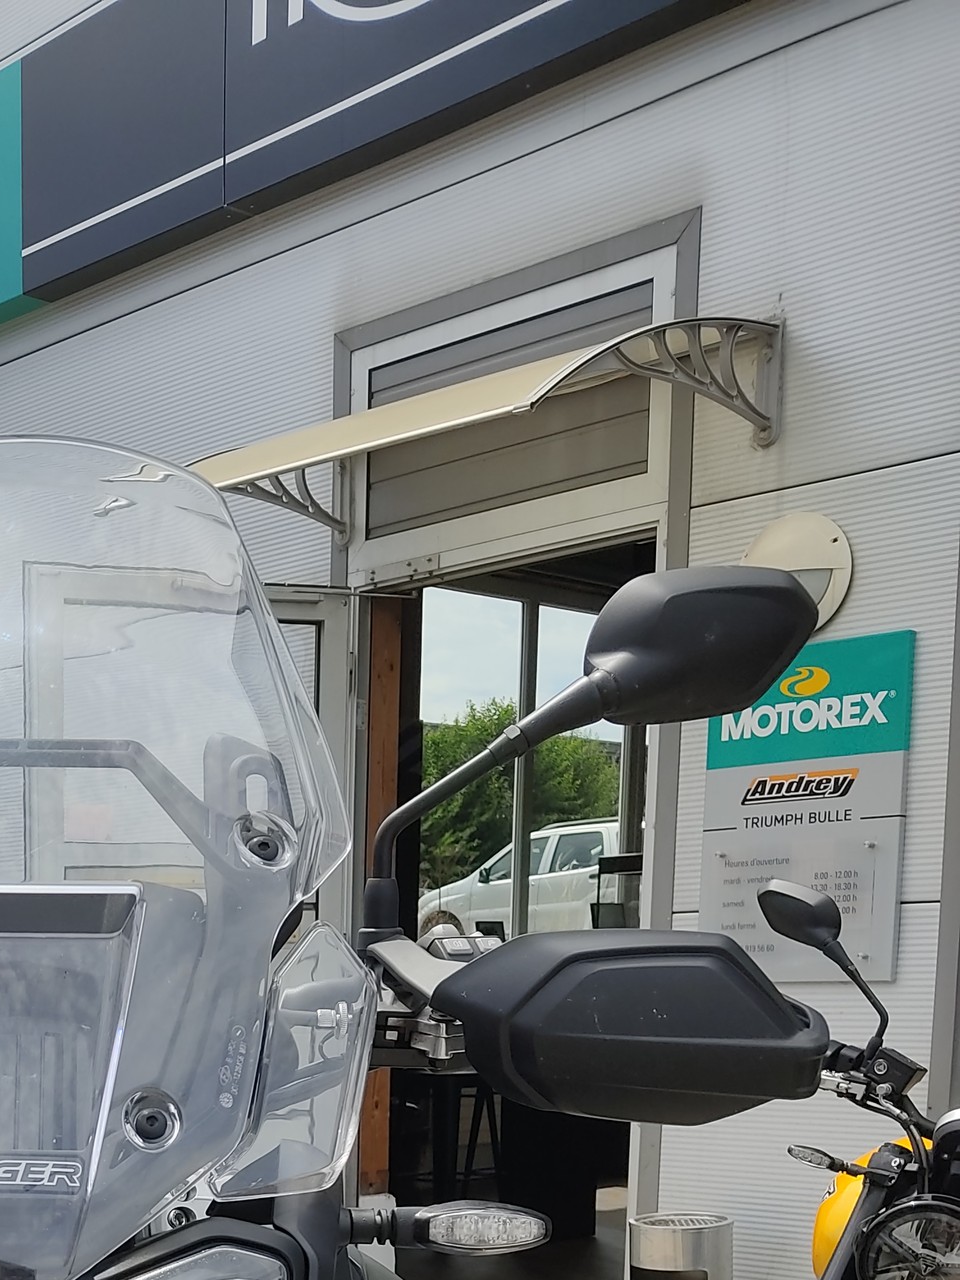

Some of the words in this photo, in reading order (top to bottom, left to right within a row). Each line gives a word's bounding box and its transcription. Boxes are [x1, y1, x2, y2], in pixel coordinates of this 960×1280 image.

[748, 774, 852, 798] Andrey
[743, 813, 804, 830] TRIUMPH
[809, 809, 853, 824] BULLE
[724, 859, 749, 868] Heures
[750, 858, 790, 867] d'ouverture
